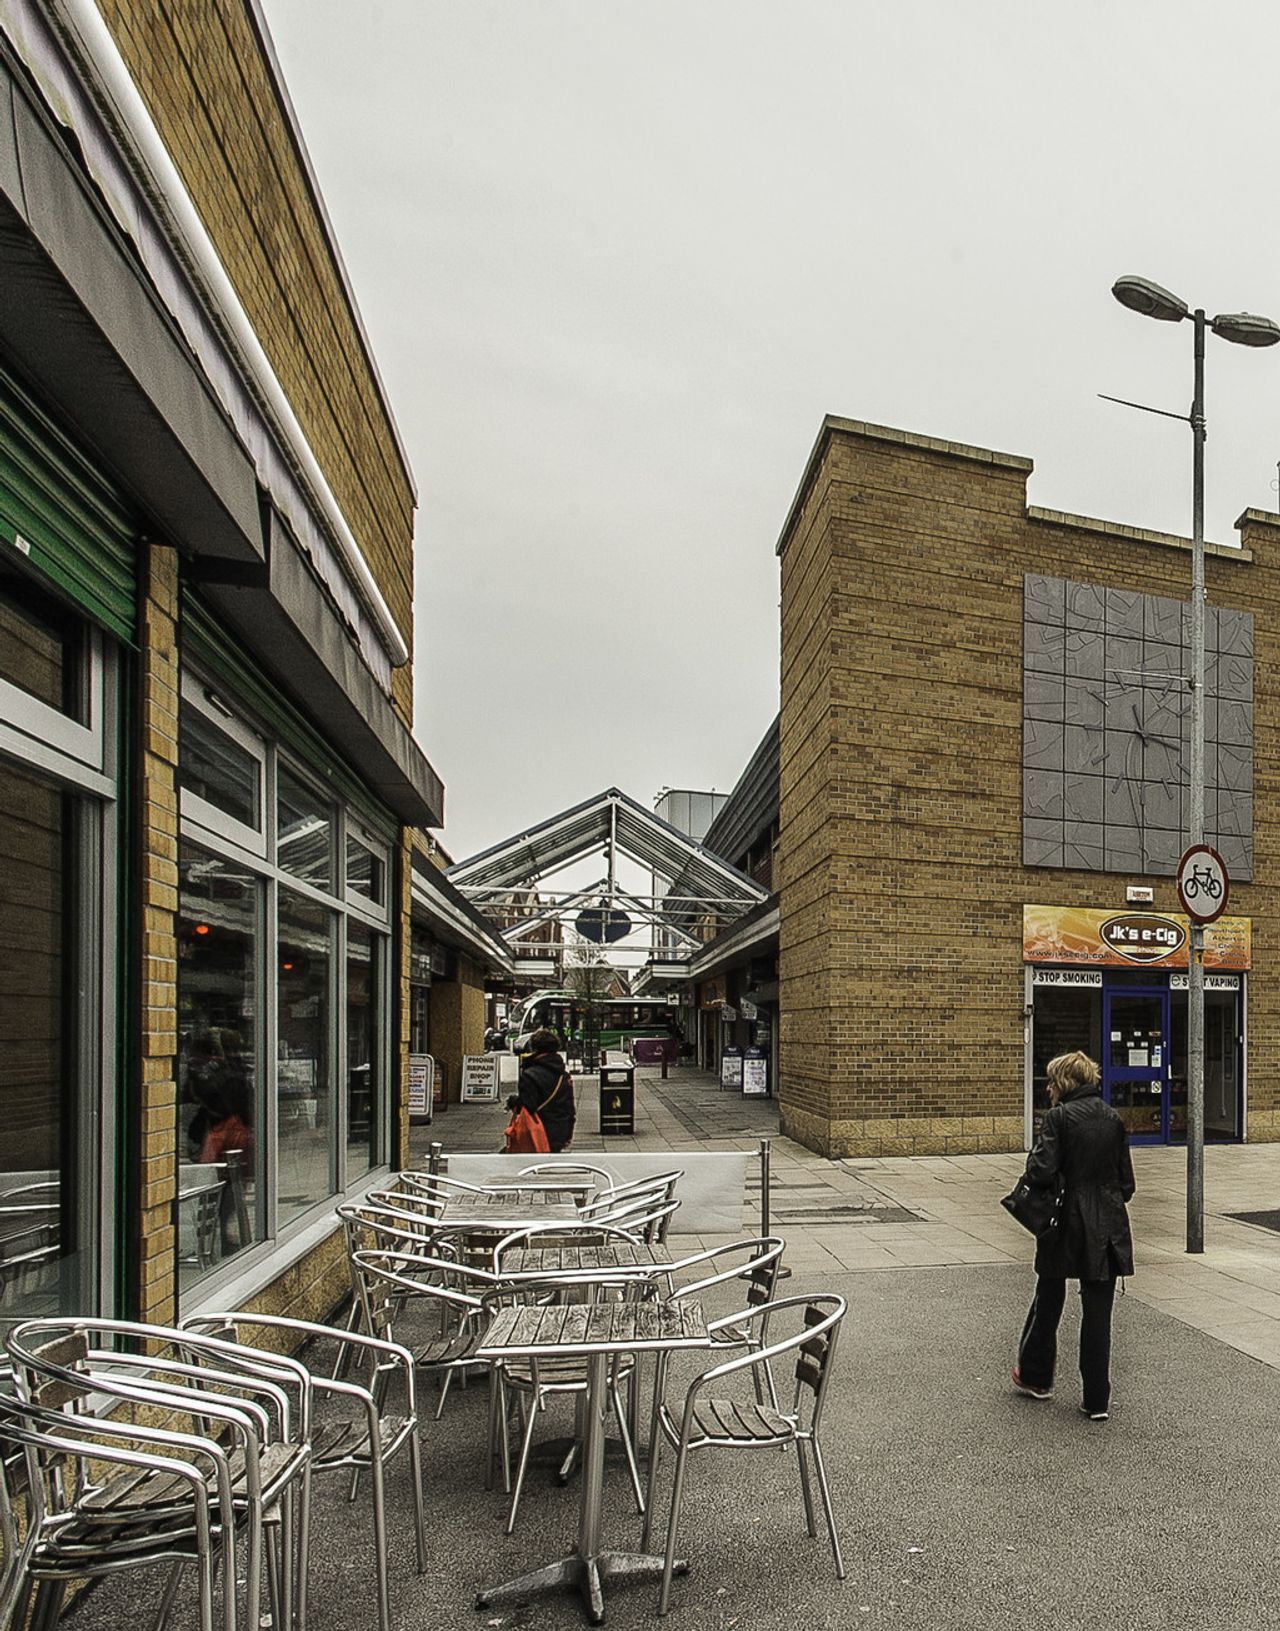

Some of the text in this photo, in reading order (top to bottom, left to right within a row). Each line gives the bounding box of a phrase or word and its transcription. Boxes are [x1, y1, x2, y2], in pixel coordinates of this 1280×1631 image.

[1038, 971, 1102, 984] STOP SMOKING
[1209, 977, 1239, 988] VAPING
